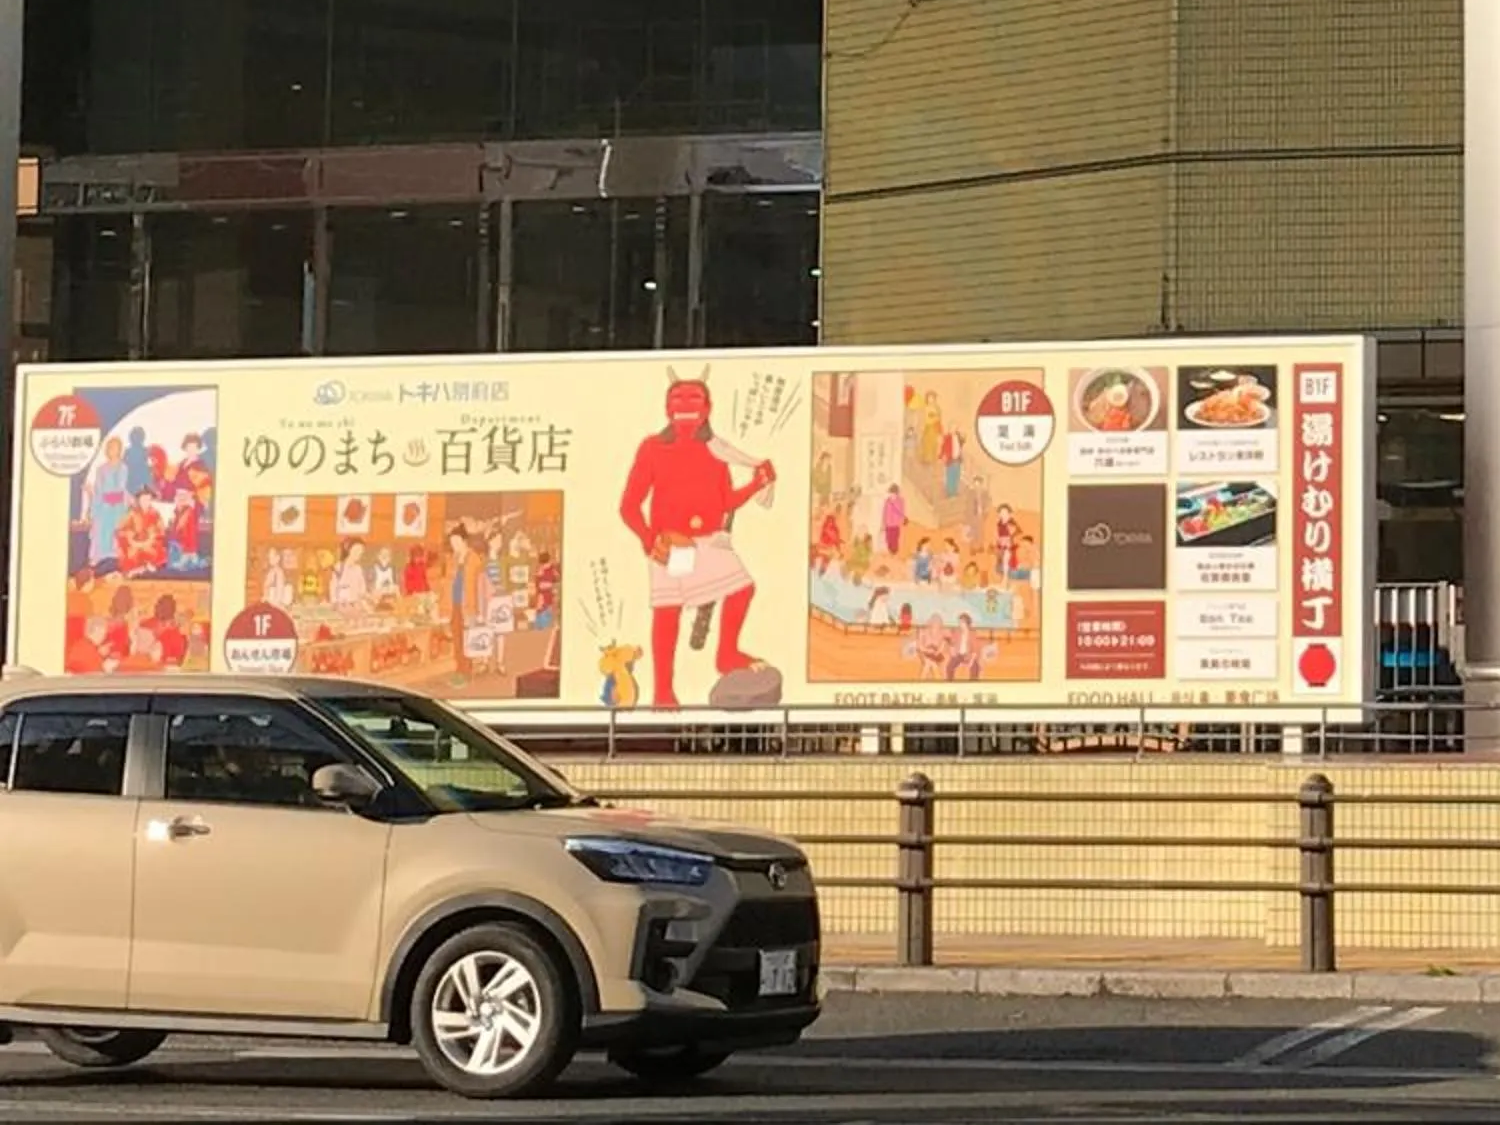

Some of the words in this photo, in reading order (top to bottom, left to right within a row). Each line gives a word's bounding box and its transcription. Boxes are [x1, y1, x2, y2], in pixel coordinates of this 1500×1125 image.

[1305, 378, 1330, 396] B1F
[1001, 390, 1032, 413] B1F
[58, 404, 77, 426] 7F
[242, 429, 396, 478] ゆのまち
[435, 423, 573, 476] 百貨店
[254, 614, 272, 636] 1F
[834, 692, 877, 707] FOOT
[881, 692, 922, 706] BATH
[1067, 690, 1112, 706] FOOD
[1117, 690, 1153, 706] HALL
